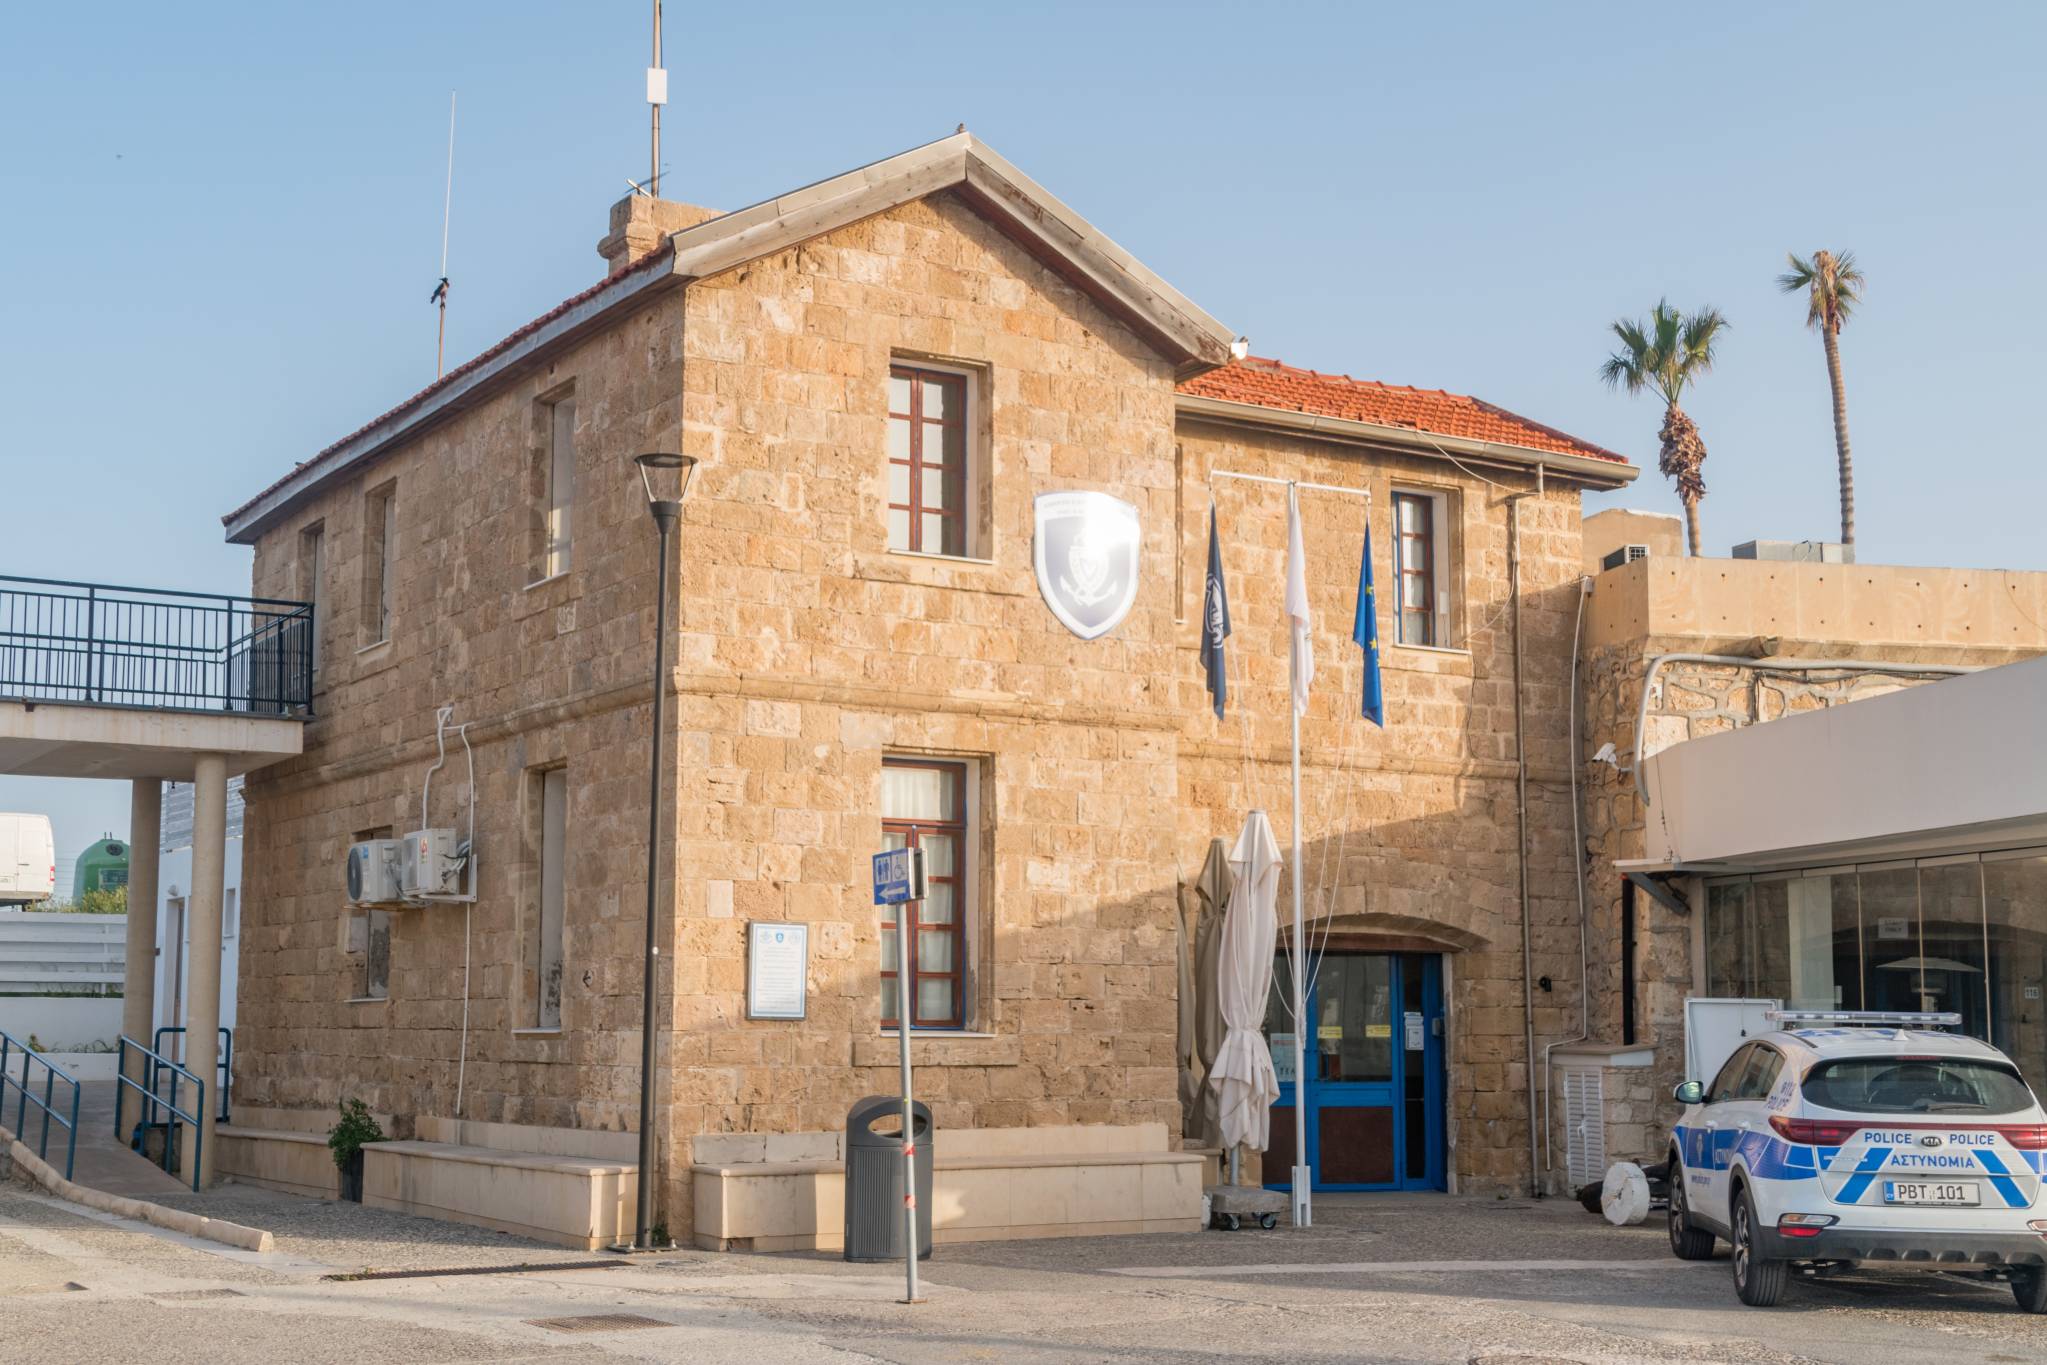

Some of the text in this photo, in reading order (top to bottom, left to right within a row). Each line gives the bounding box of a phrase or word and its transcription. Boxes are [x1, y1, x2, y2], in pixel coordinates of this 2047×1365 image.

[1864, 1132, 1912, 1144] POLICE
[1922, 1137, 1942, 1146] KIA
[1949, 1134, 1995, 1145] POLICE
[1890, 1154, 1976, 1169] ΑΣΤΥΝΟΜΙΑ
[1897, 1184, 1966, 1200] PBT 101
